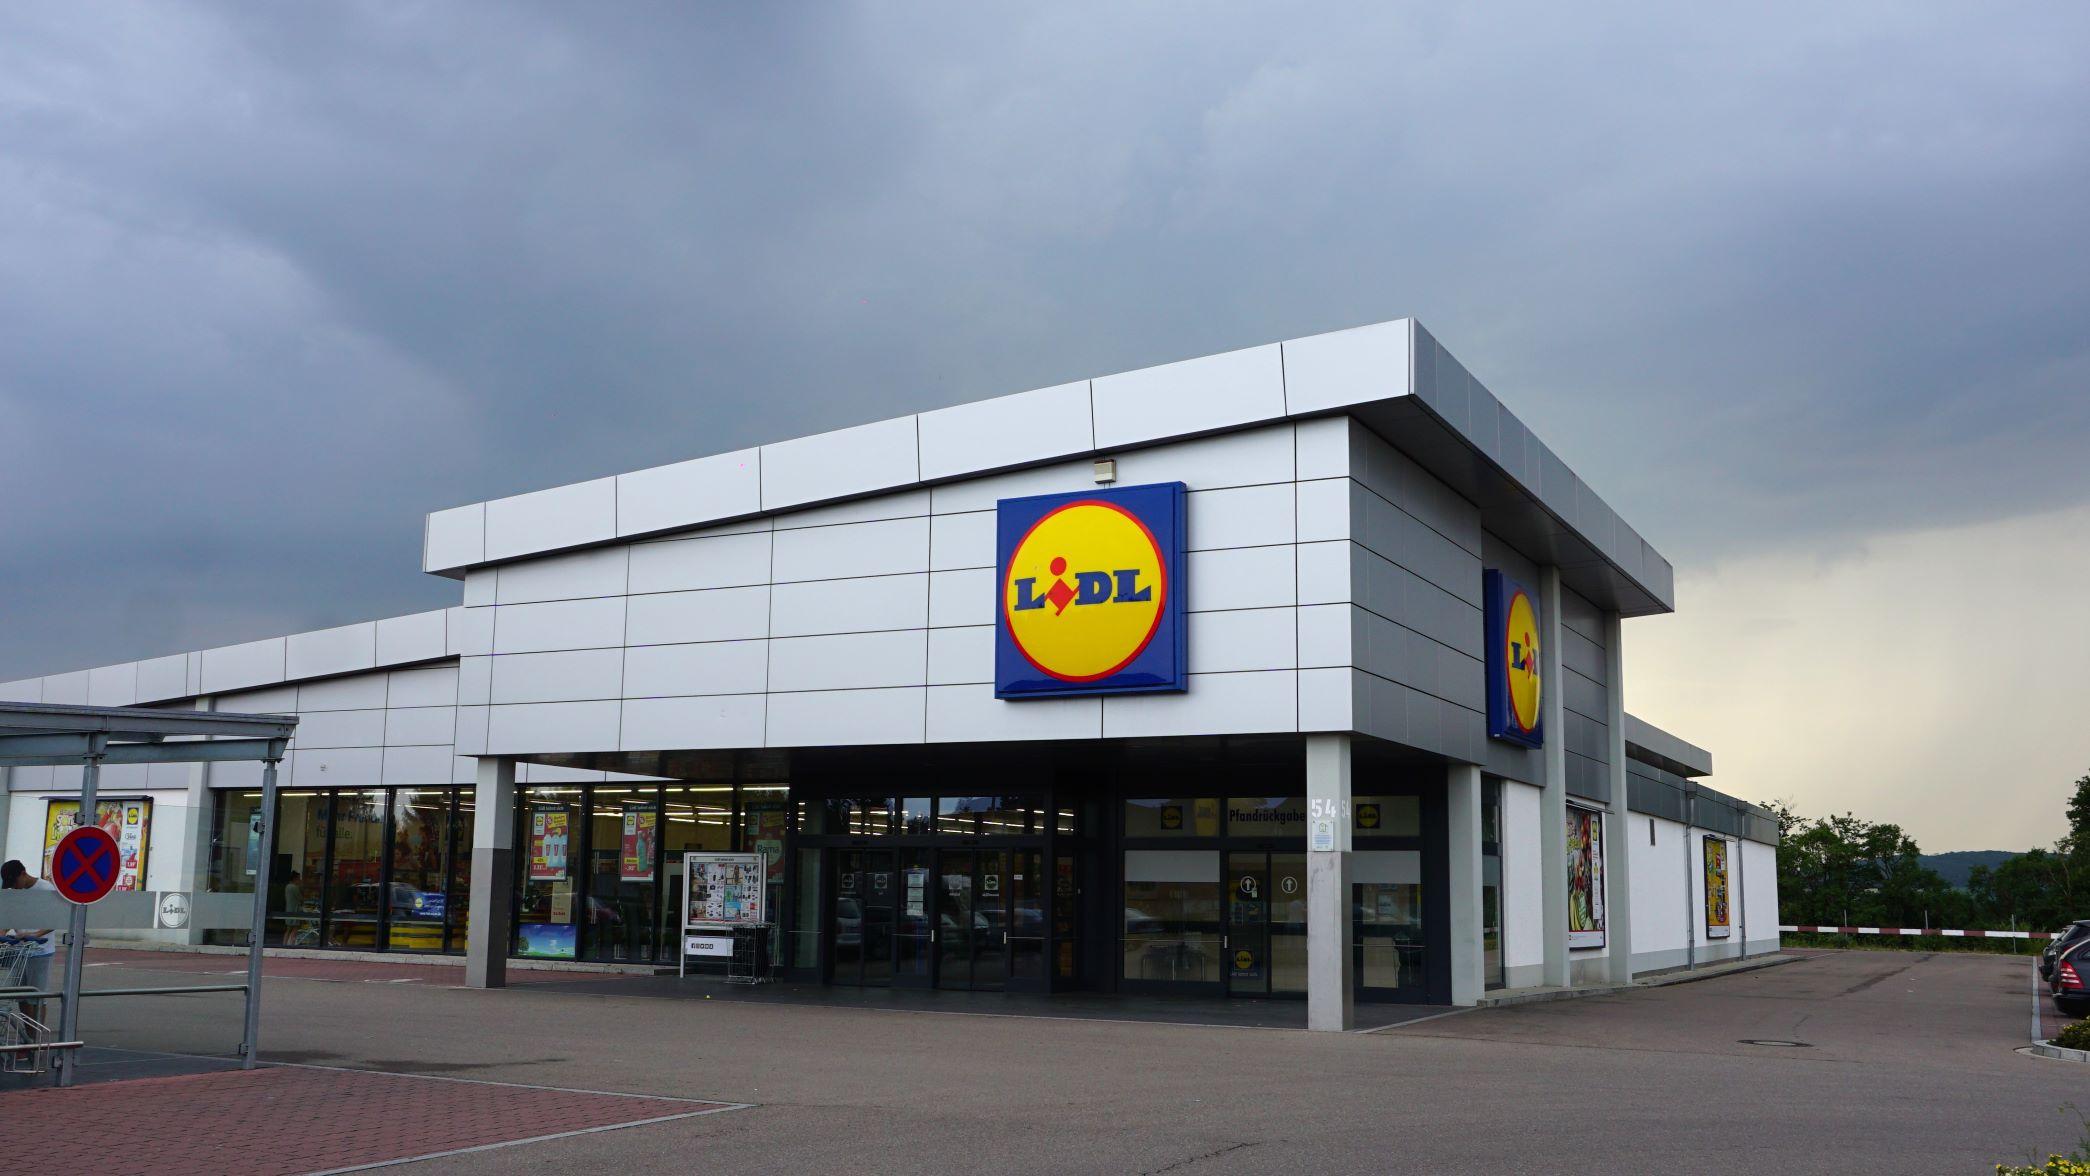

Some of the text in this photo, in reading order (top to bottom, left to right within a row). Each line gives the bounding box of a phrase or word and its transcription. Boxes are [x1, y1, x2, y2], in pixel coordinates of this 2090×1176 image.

[1013, 556, 1152, 616] LIDL
[1229, 807, 1306, 825] Pfandrückgabe
[1311, 798, 1337, 818] 54
[162, 903, 186, 915] LIDL
